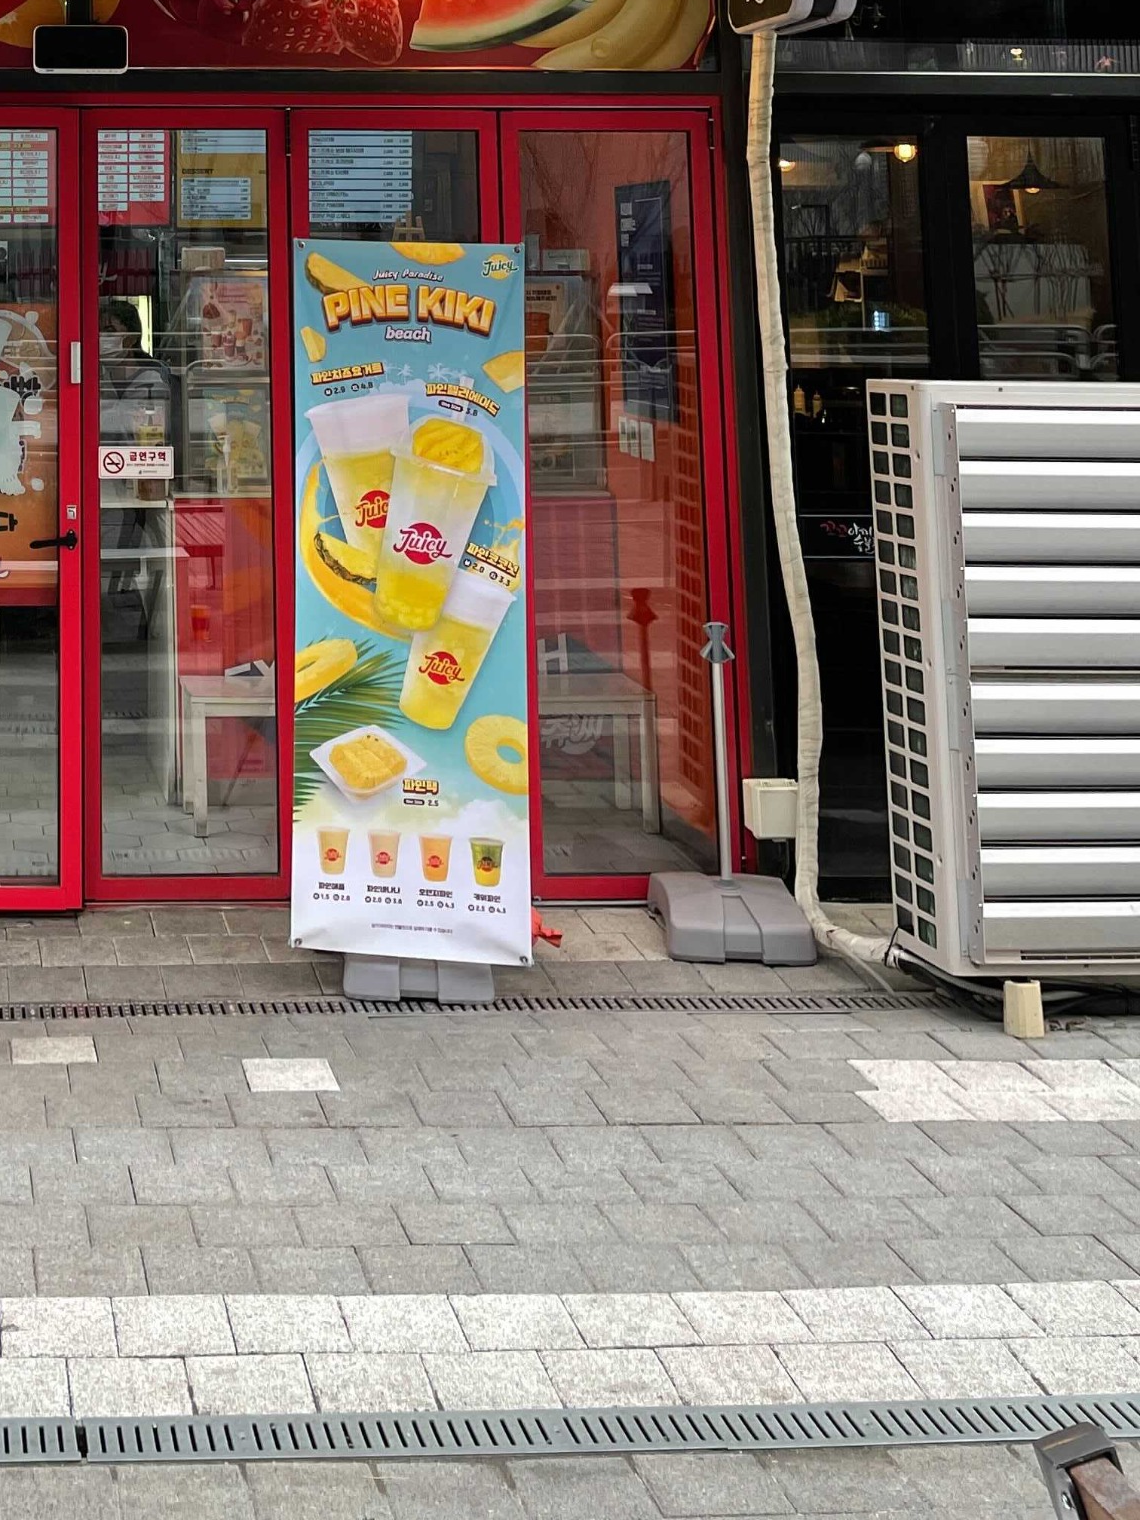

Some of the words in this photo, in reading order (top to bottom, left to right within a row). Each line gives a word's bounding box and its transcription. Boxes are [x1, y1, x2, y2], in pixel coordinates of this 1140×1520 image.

[482, 259, 518, 277] Juicy
[322, 284, 411, 332] PINE
[416, 284, 496, 337] KIKI
[384, 326, 433, 343] beach
[129, 451, 166, 462] 금연구역
[355, 493, 389, 526] Juic
[393, 528, 453, 559] Juicy
[418, 654, 465, 682] Juicy
